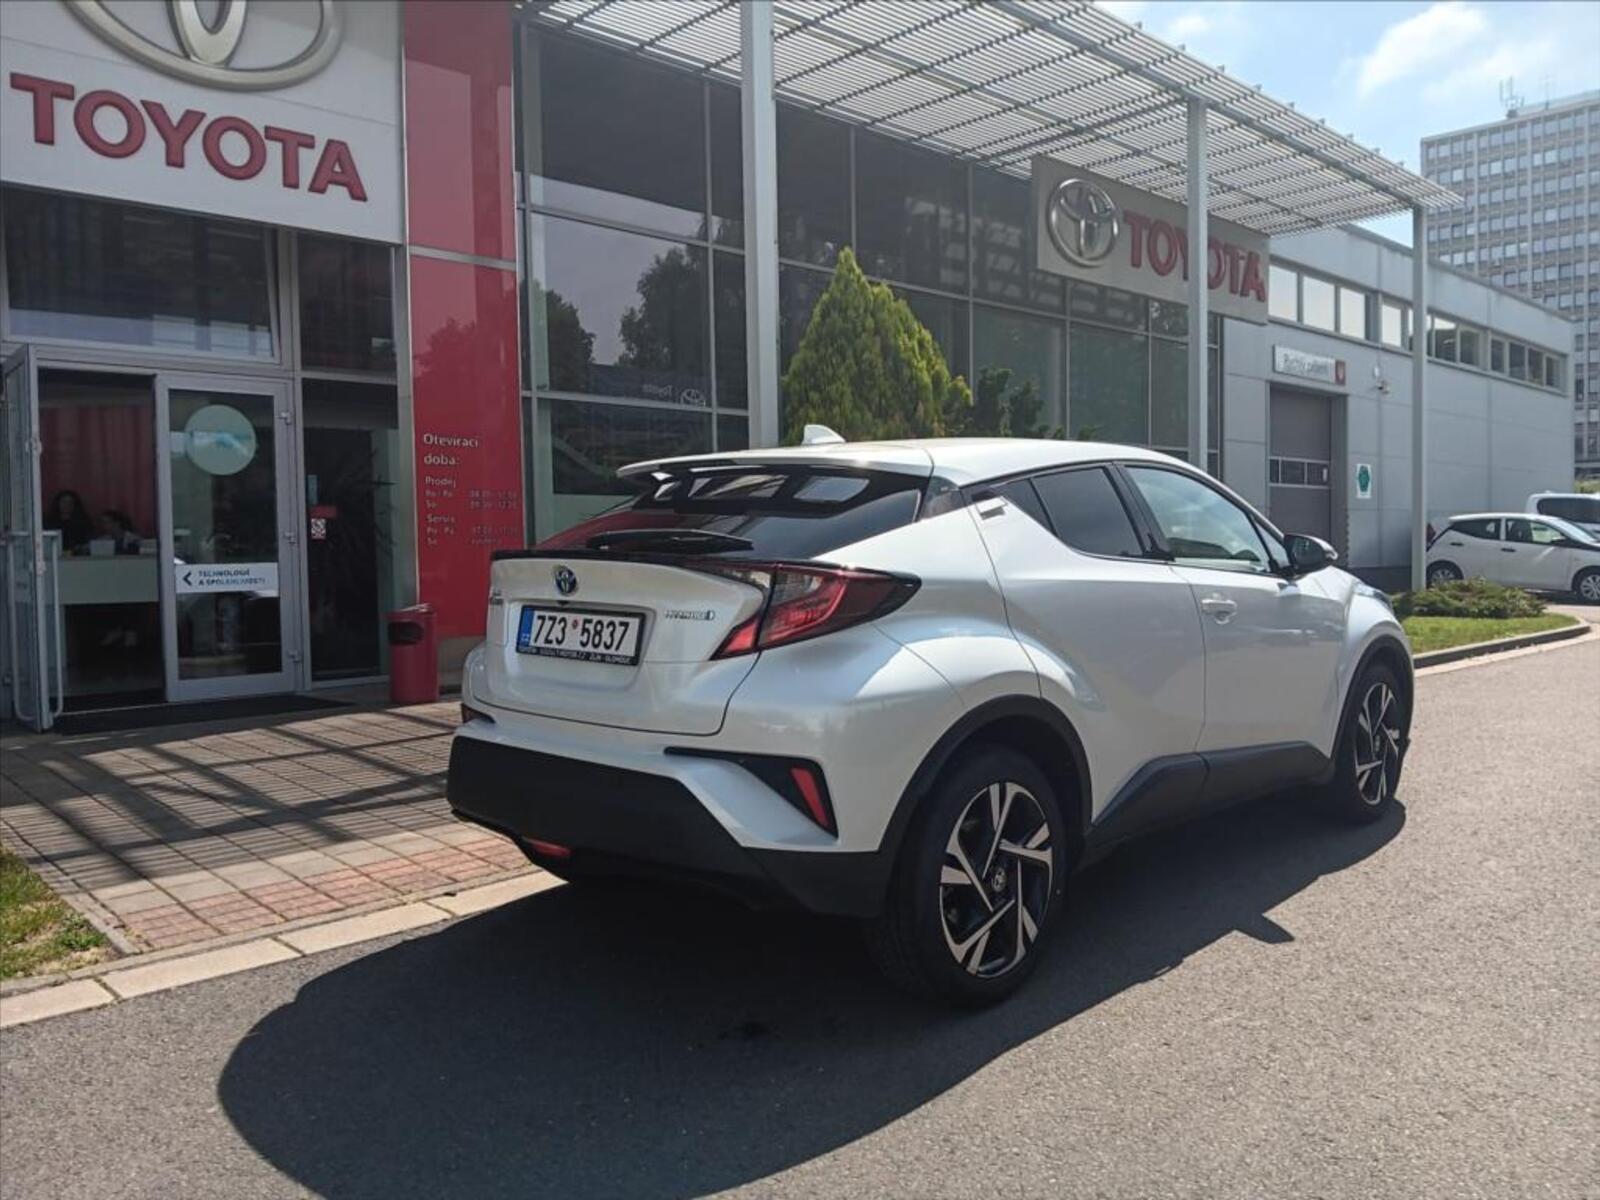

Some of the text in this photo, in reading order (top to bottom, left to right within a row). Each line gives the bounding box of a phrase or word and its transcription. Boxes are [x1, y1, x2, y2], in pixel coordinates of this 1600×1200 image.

[10, 72, 368, 202] TOYOTA
[533, 614, 630, 652] 7Z3 5837
